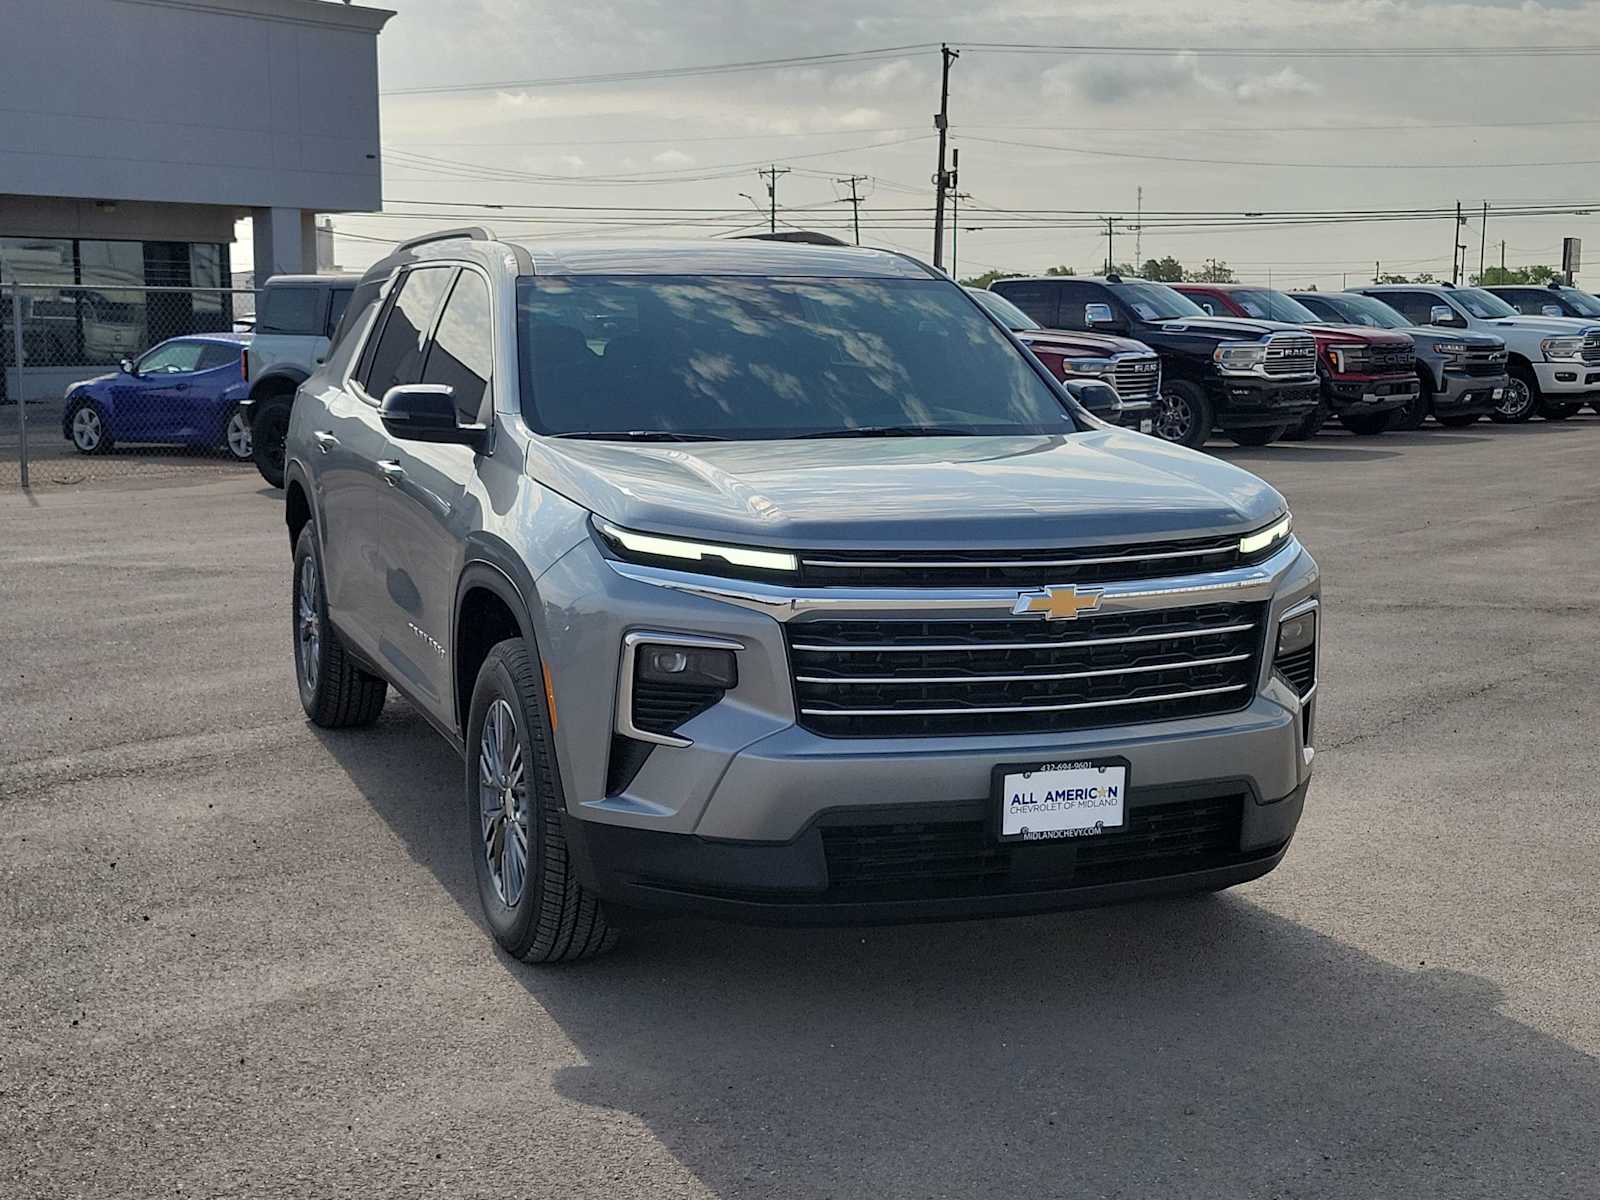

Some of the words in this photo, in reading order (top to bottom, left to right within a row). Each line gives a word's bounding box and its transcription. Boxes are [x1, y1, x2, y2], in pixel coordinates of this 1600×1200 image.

[1011, 793, 1038, 805] ALL
[1009, 802, 1062, 815] CHEVROLET
[1063, 801, 1077, 810] OF
[1078, 798, 1118, 809] MIDLAND
[1023, 827, 1102, 841] MIDLANDCHEVY.COM
